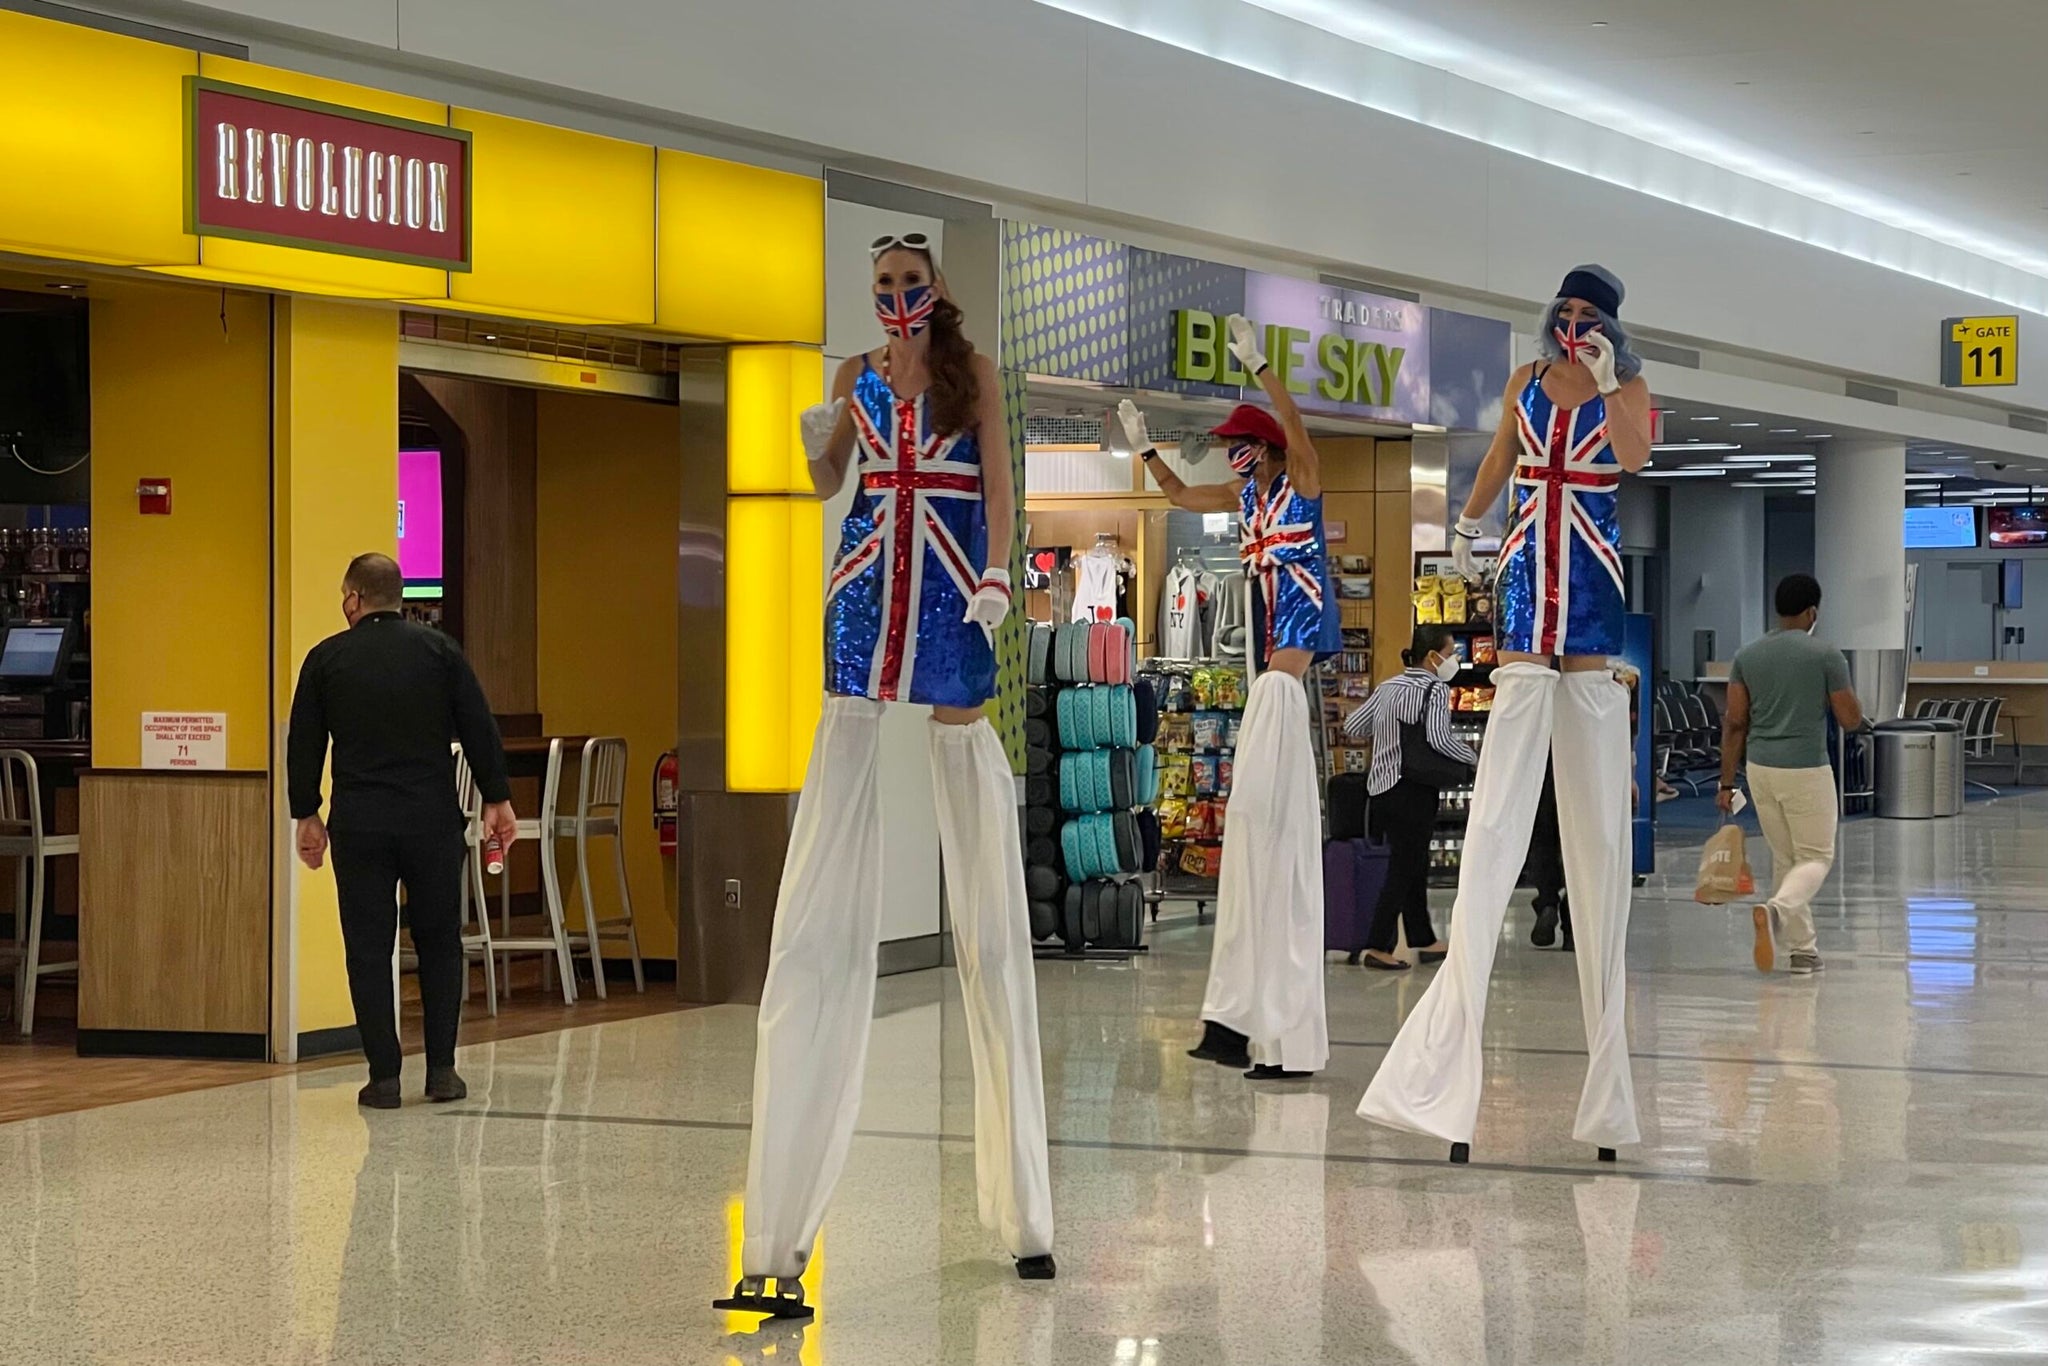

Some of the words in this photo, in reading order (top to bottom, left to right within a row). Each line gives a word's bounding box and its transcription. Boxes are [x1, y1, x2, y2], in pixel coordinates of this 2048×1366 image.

[217, 122, 449, 232] REVOLUCION
[1319, 297, 1402, 332] TRADERS
[1976, 326, 2011, 338] GATE
[1177, 309, 1311, 395] BLUE
[1316, 333, 1406, 407] SKY
[1968, 346, 2003, 377] 11
[181, 716, 214, 724] PERMITTED
[188, 733, 211, 741] EXCEED
[178, 745, 188, 757] 71
